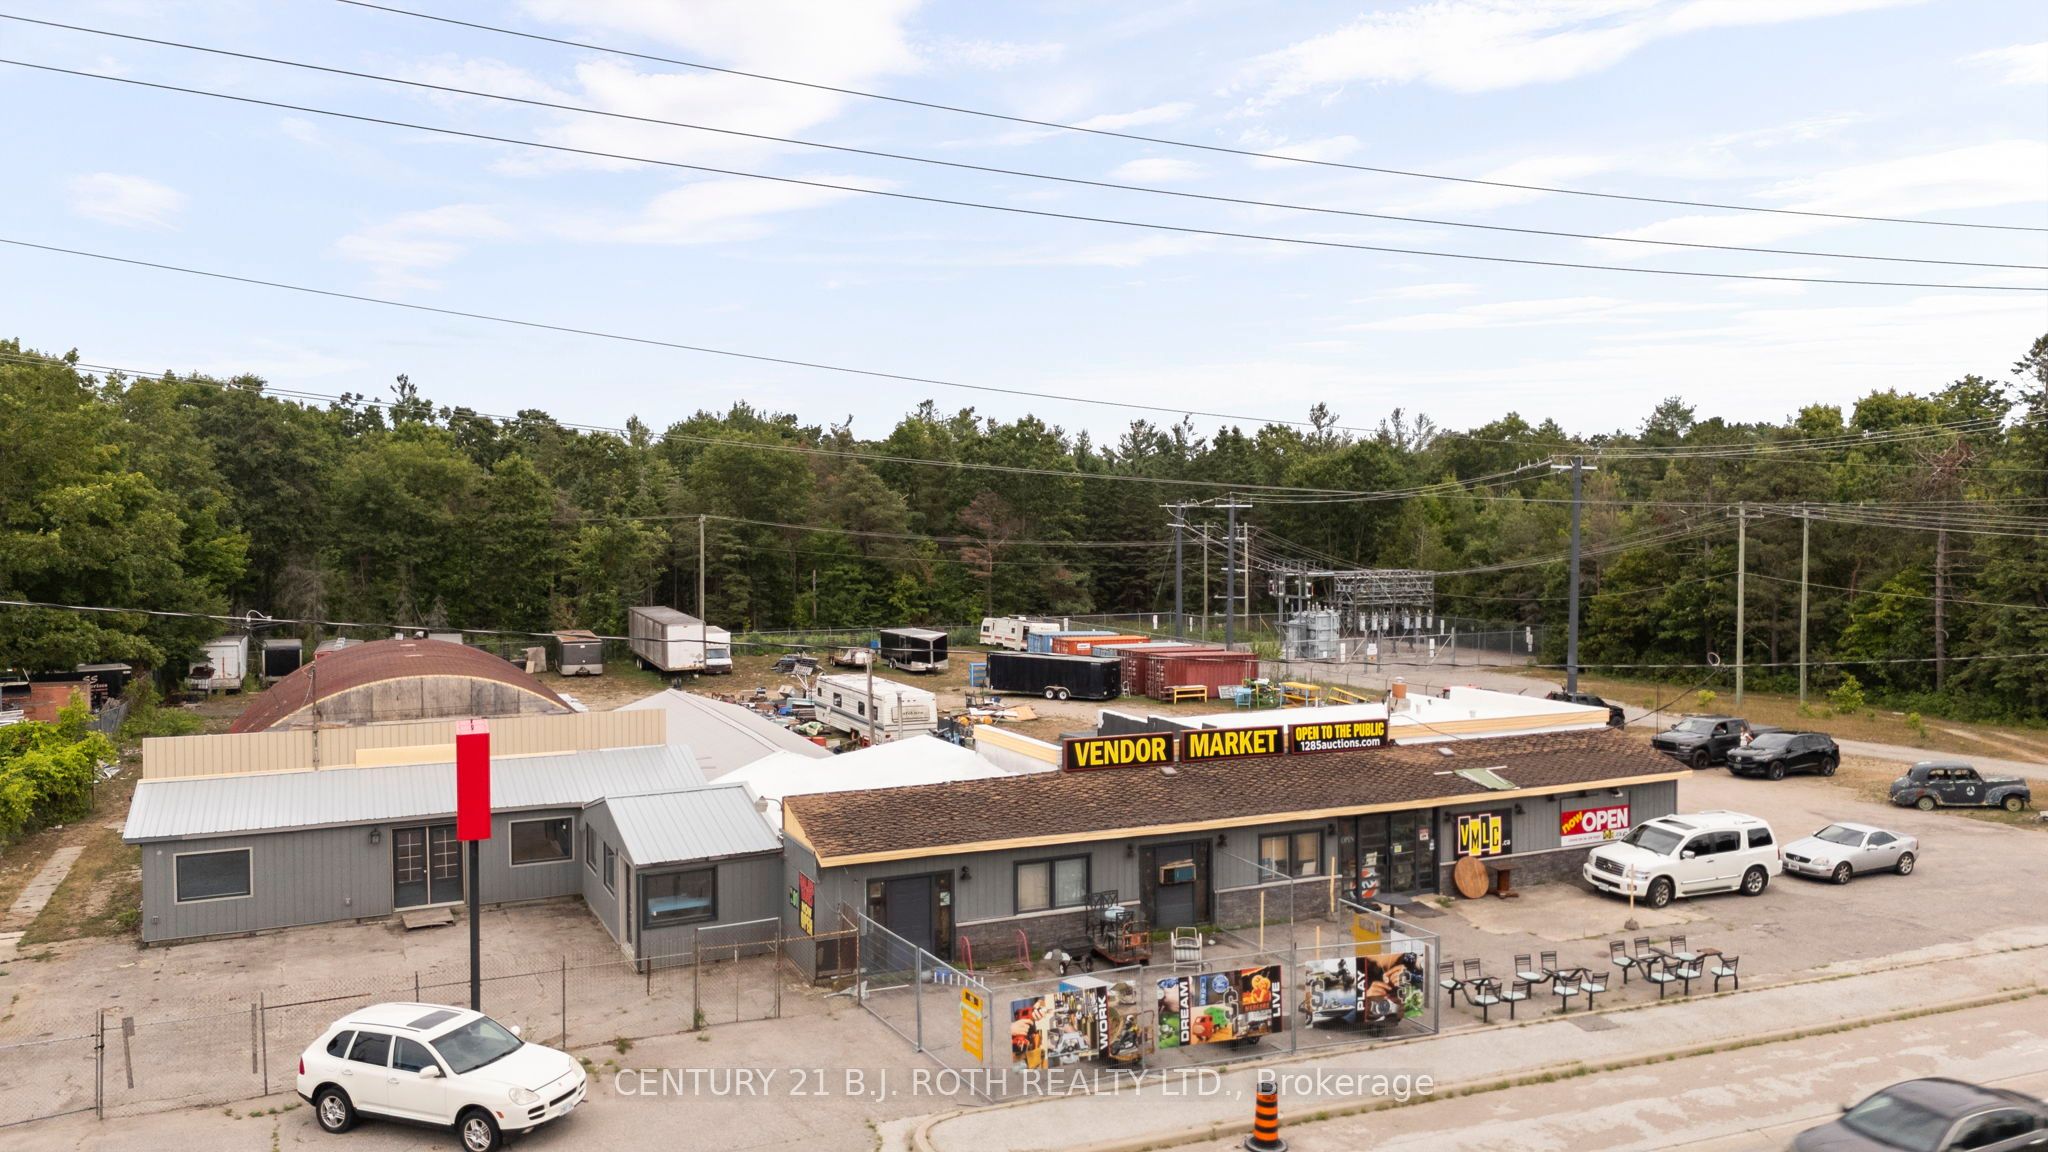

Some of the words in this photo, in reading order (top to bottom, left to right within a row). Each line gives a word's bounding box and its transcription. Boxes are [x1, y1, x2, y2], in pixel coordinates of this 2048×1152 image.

[1189, 729, 1278, 758] MARKET
[1295, 725, 1319, 741] OPEN
[1321, 725, 1333, 739] TO
[1334, 723, 1351, 739] THE
[1353, 721, 1385, 737] PUBLIC
[1300, 738, 1380, 751] 1285auctions.com
[1074, 737, 1166, 767] VENDOR
[1562, 811, 1583, 834] now
[1582, 807, 1629, 832] OPEN
[1272, 981, 1280, 1018] LIVE
[1356, 971, 1366, 1012] PLAY
[1098, 996, 1108, 1050] WORK
[1180, 981, 1189, 1042] DREAM
